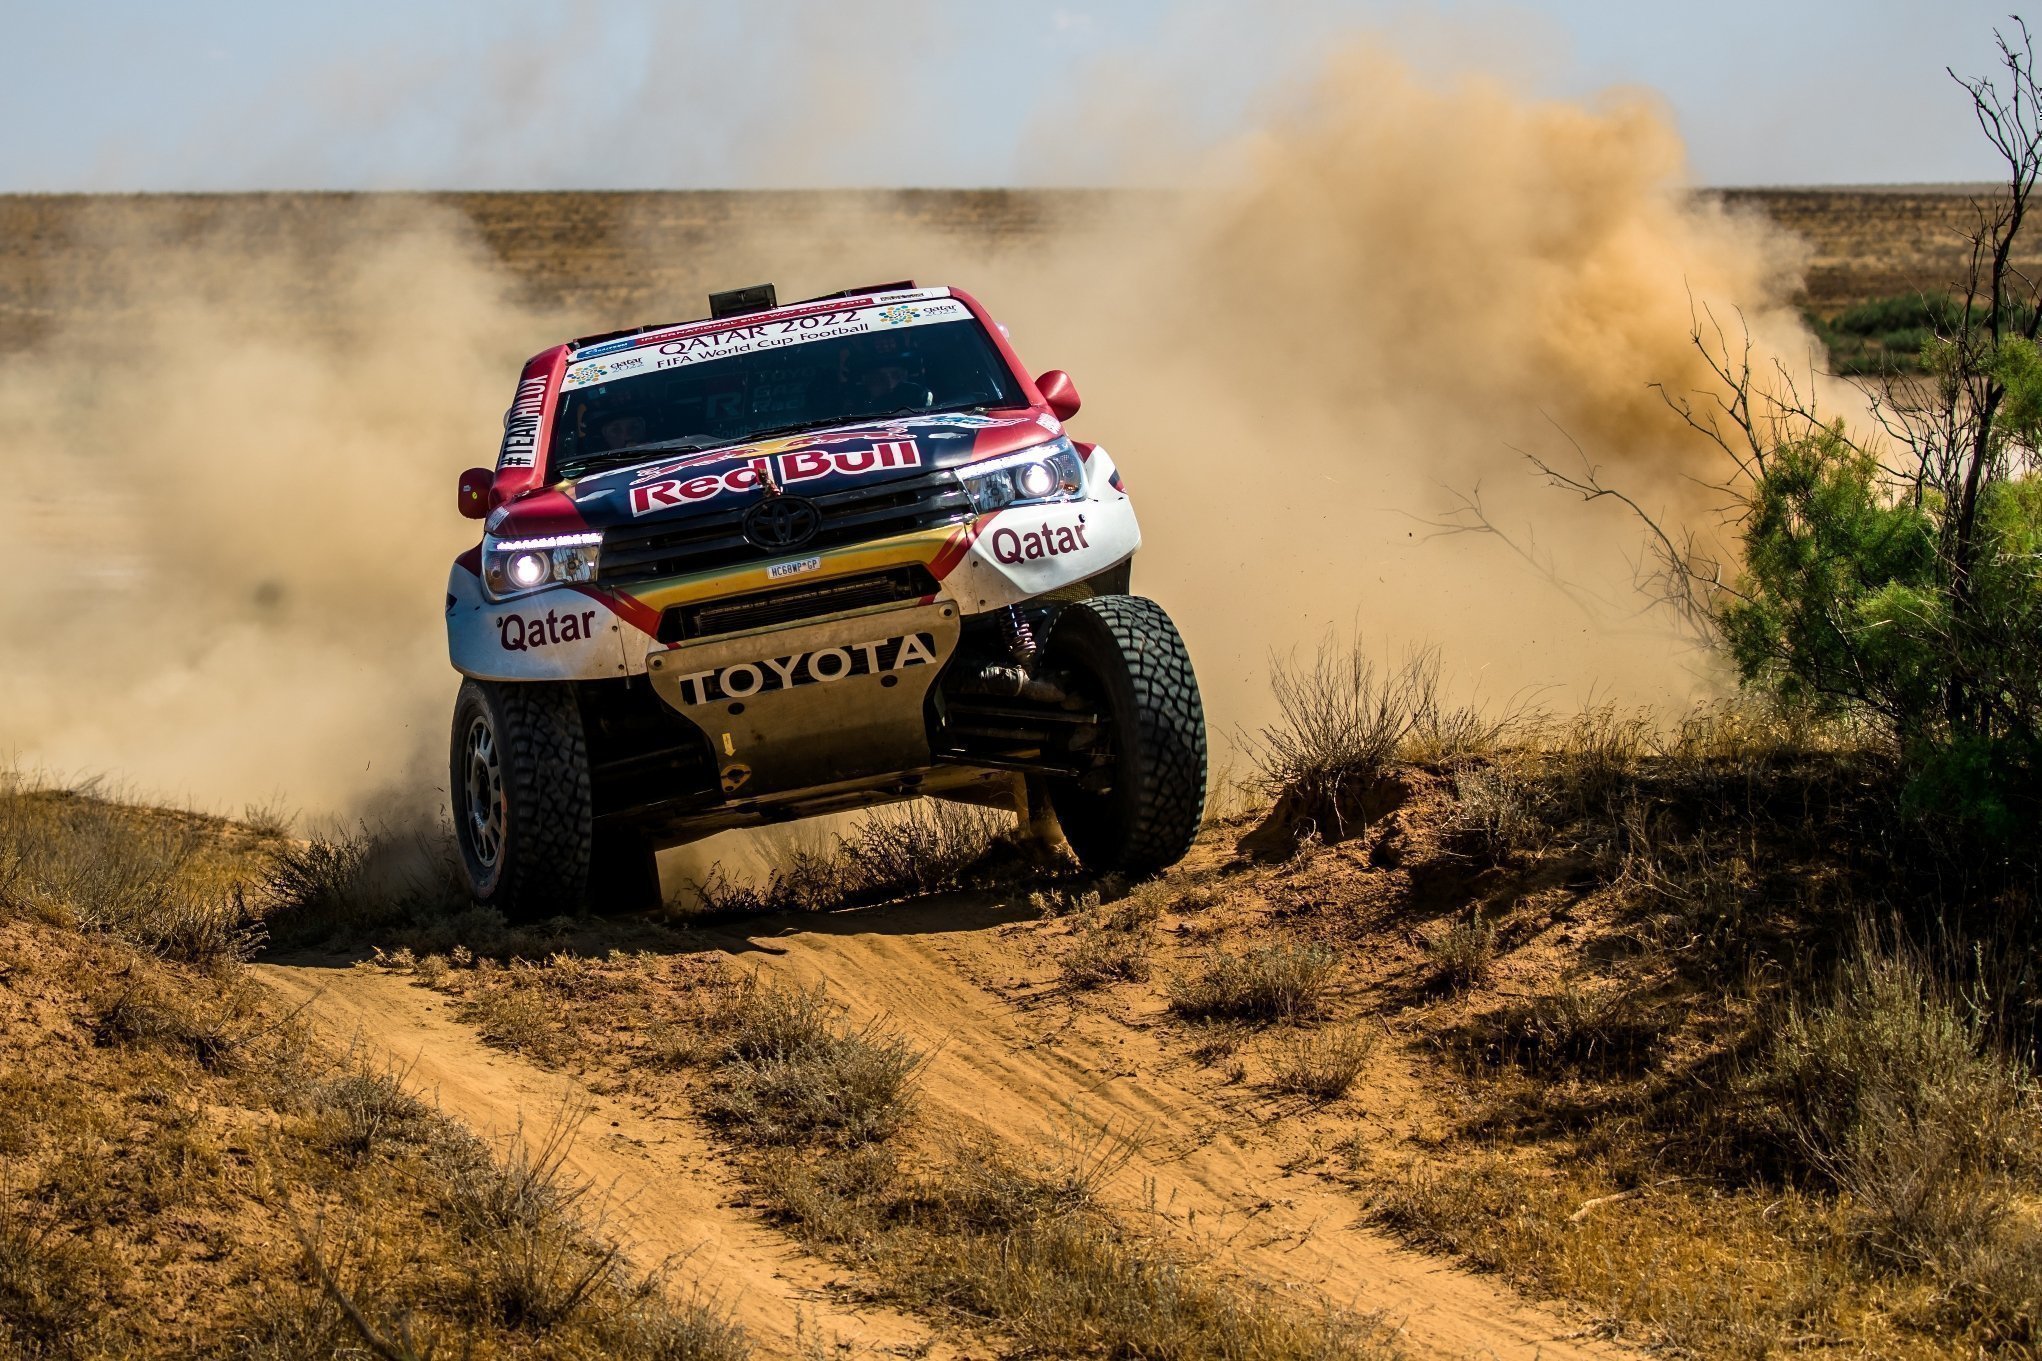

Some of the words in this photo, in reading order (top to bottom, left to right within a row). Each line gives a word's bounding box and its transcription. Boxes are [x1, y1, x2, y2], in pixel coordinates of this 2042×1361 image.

[641, 321, 738, 342] INTERNATIONAL
[740, 315, 765, 323] SILK
[799, 303, 837, 313] RALLY
[658, 326, 768, 355] QATAR
[781, 310, 861, 334] 2022
[656, 355, 694, 369] FIFA
[698, 343, 751, 360] World
[757, 337, 794, 348] Cup
[800, 323, 869, 341] Football
[500, 374, 548, 466] #TEAMHILUX
[630, 457, 772, 516] Red
[777, 440, 921, 484] Bull
[992, 521, 1089, 564] Qatar
[501, 609, 595, 652] Qatar
[678, 633, 937, 705] TOYOTA
